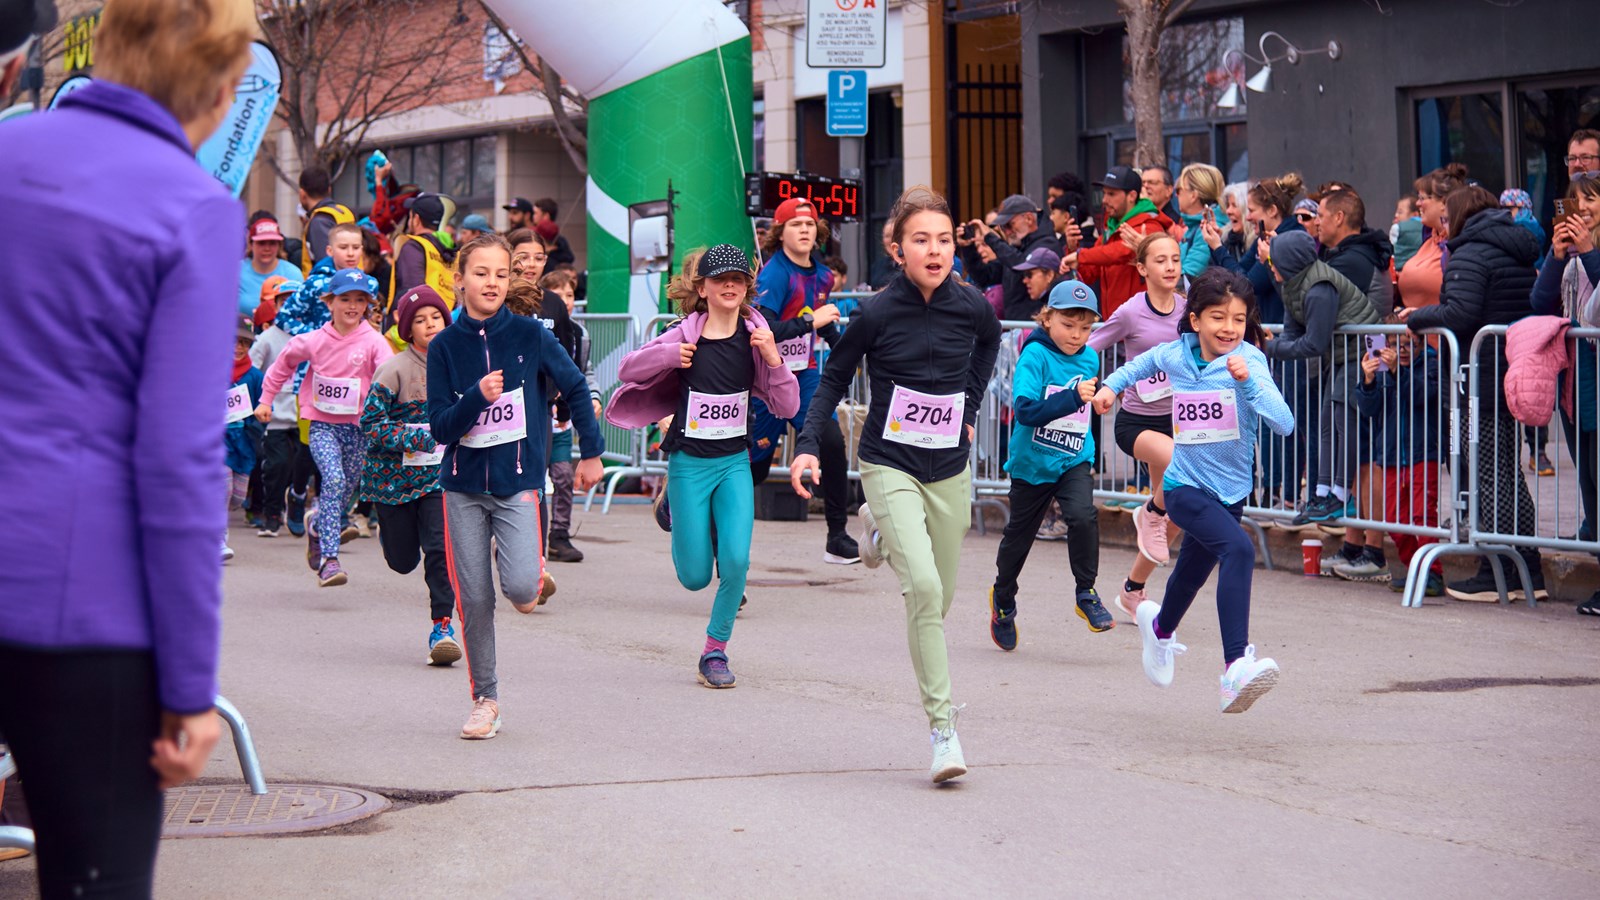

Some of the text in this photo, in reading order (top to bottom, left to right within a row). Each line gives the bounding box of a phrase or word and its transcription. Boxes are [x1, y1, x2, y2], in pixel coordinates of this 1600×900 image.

[839, 75, 856, 98] P
[213, 98, 256, 183] Fondation
[781, 342, 807, 356] 3026
[318, 383, 350, 399] 2887
[474, 403, 514, 425] 703
[699, 403, 739, 420] 2886
[904, 403, 953, 425] 2704
[1178, 402, 1223, 421] 2838
